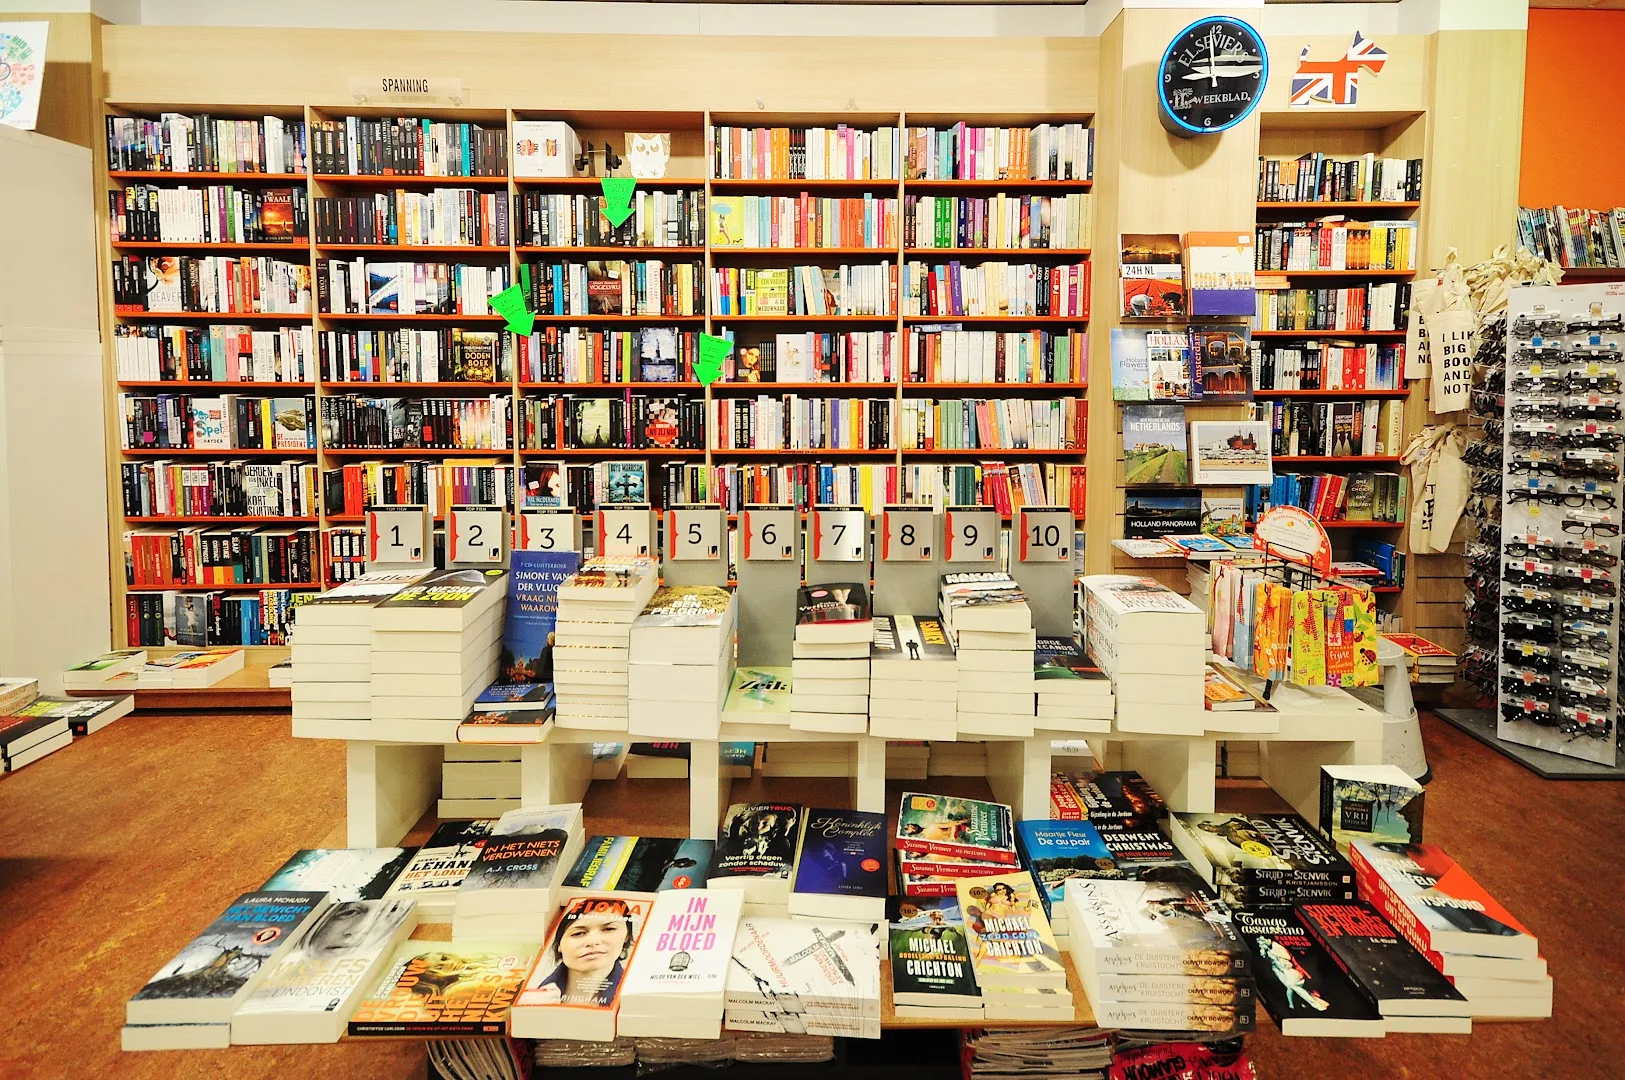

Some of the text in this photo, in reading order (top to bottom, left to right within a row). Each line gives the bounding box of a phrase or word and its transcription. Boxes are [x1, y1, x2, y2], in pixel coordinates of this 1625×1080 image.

[1211, 25, 1223, 34] 12
[1164, 74, 1172, 83] 9
[382, 78, 429, 93] SPANNING
[1204, 117, 1212, 126] 6
[263, 195, 291, 203] TWAALF
[498, 212, 506, 239] CITADEL
[1125, 265, 1155, 276] 24H NL
[1149, 334, 1188, 347] HOLLAN
[1442, 331, 1475, 343] I LIK
[1443, 344, 1467, 355] BIG
[465, 352, 491, 360] DODEN
[1194, 332, 1203, 385] Amsterdam
[468, 359, 490, 367] BOEK
[1119, 360, 1148, 368] Flowers
[1443, 357, 1471, 369] BOO
[1443, 370, 1471, 381] AND
[1444, 384, 1470, 395] NOT
[1130, 422, 1181, 432] NETHERLANDS
[277, 439, 307, 449] PRESIDENT
[245, 466, 273, 477] JEROEN
[257, 476, 278, 488] INKEL
[247, 495, 266, 506] KORT
[1131, 520, 1197, 528] HOLLAND PANORAMA
[391, 525, 404, 547] 1
[468, 525, 484, 547] 2
[540, 528, 555, 549] 3
[616, 523, 633, 545] 4
[688, 523, 702, 545] 5
[761, 523, 777, 545] 6
[831, 525, 847, 546] 7
[900, 524, 915, 546] 8
[963, 525, 978, 547] 9
[1030, 525, 1060, 547] 10
[515, 571, 570, 581] SIMONE VAN
[517, 582, 560, 592] DER VLUG
[418, 592, 475, 601] ZOON
[515, 594, 544, 603] VRAAG
[520, 604, 559, 613] WAAROM
[651, 607, 716, 616] PELGRIM
[1038, 837, 1056, 846] De
[1071, 837, 1091, 848] pair
[1103, 833, 1161, 843] DERWENT
[485, 840, 561, 854] IN HET NIETS
[904, 840, 928, 850] Suzanne
[928, 843, 952, 853] Vermeer
[1105, 842, 1173, 852] CHRISTMAS
[482, 848, 558, 862] VERDWENEN
[725, 854, 783, 863] Veertig dagen
[411, 860, 472, 872] LEHAN
[506, 864, 539, 872] CROSS
[579, 837, 615, 888] FAMILIEGRAF
[719, 860, 787, 868] zonder schaduw
[405, 869, 470, 879] HET LOKE
[910, 864, 959, 875] Suzanne Vermeer
[1294, 870, 1330, 881] STENVIK
[571, 901, 642, 916] FIONA
[687, 897, 709, 914] IN
[1404, 895, 1486, 912] ONTSPOORD
[252, 914, 296, 923] BLOED
[667, 914, 717, 932] MIJN
[1235, 912, 1287, 928] Tango
[984, 917, 1032, 933] MICHAEL
[1241, 925, 1305, 936] assassino
[656, 932, 717, 952] BLOED
[909, 938, 957, 955] MICHAEL
[986, 941, 1044, 957] CRICHTON
[906, 959, 963, 978] CRICHTON
[272, 986, 351, 998] LINDQVIST
